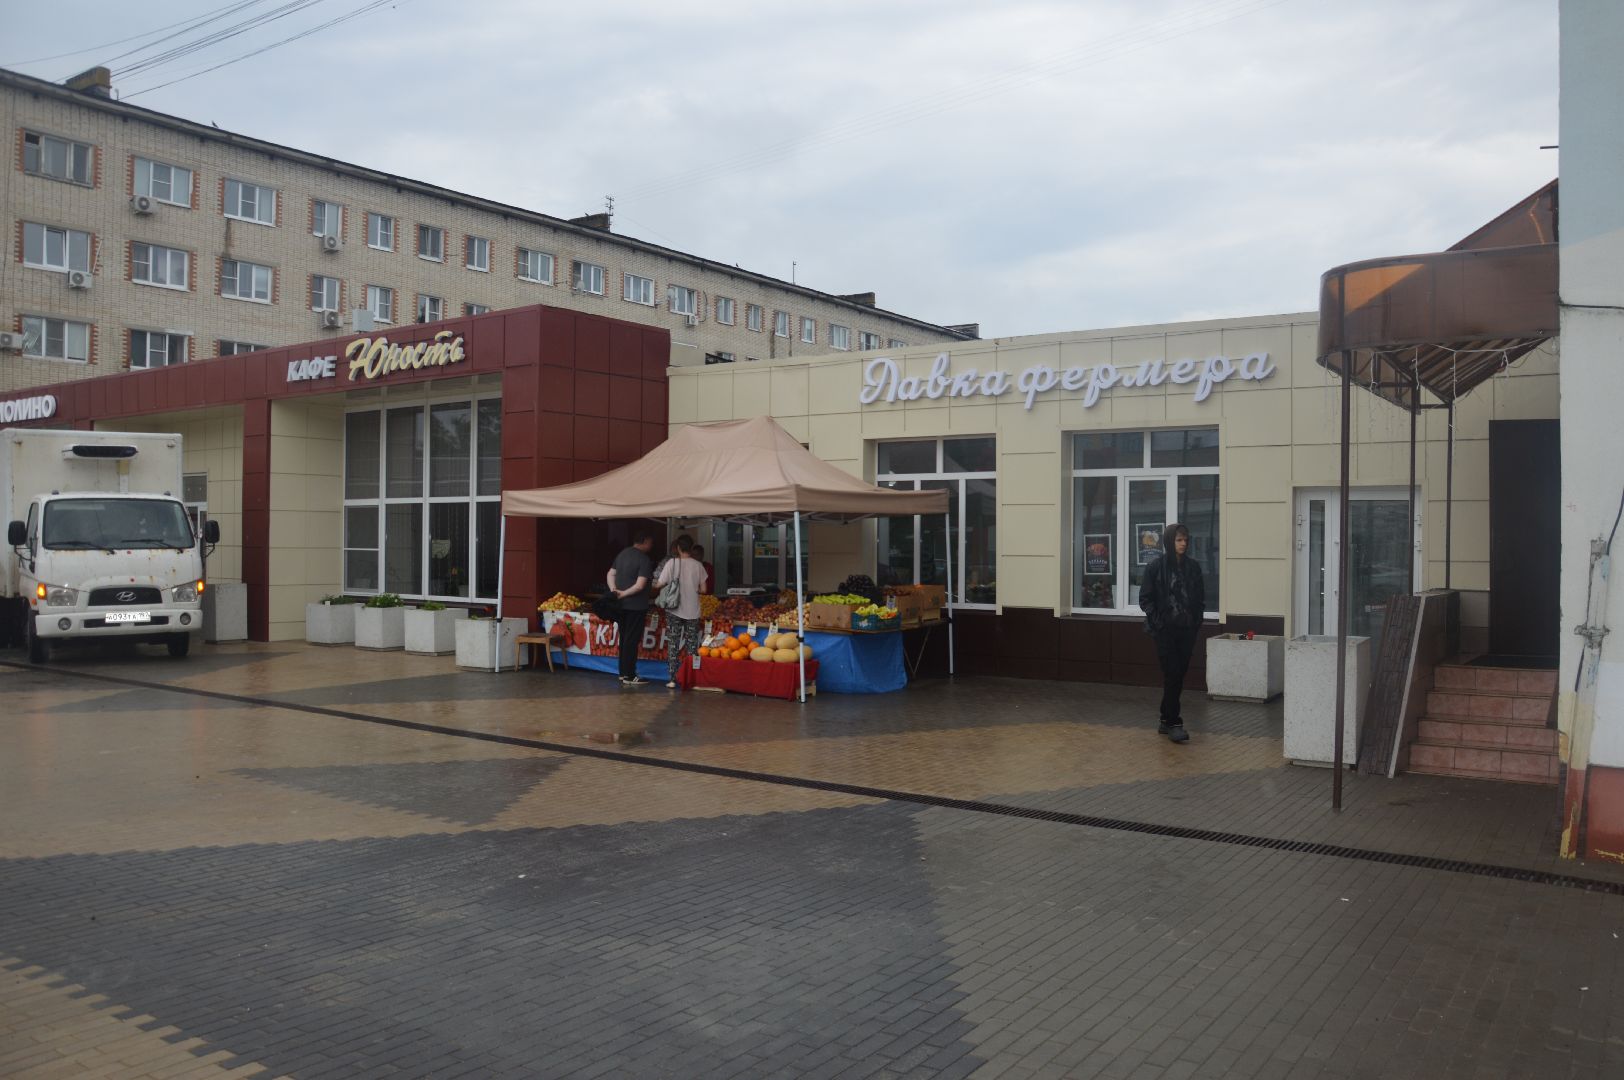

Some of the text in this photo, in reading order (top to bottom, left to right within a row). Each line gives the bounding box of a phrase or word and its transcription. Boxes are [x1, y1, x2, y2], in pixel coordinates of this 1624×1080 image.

[287, 331, 466, 382] КАФЕ Юность
[860, 352, 1276, 410] Лавка фермера
